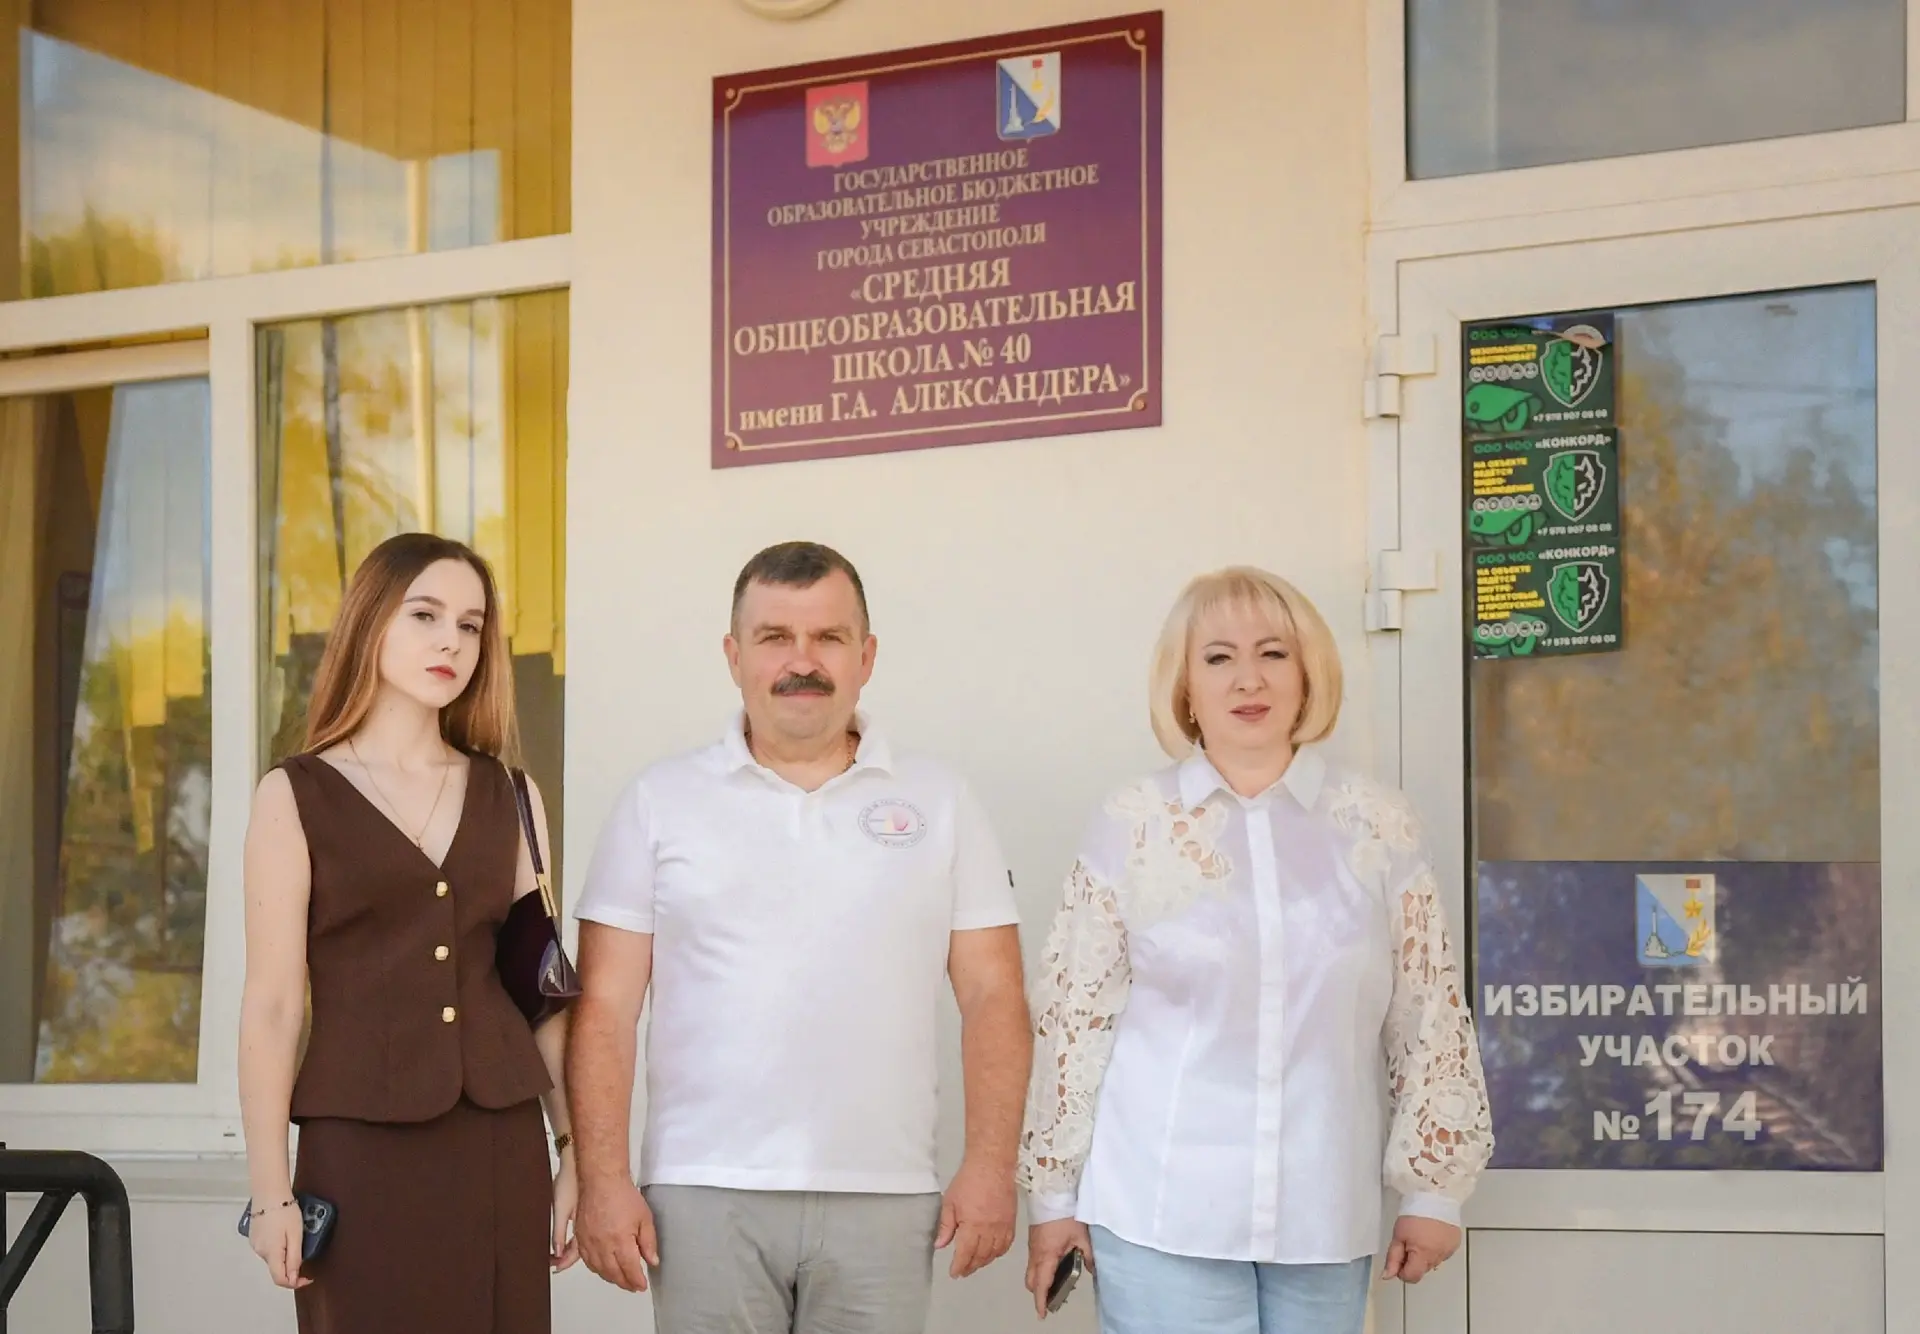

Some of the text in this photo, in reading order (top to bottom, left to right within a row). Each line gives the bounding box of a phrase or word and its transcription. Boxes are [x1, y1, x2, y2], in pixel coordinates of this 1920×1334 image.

[834, 148, 1028, 193] ГОСУДАРСТВЕННОЕ
[767, 164, 1099, 226] ОБРАЗОВАТЕЛЬНОЕ БЮДЖЕТНОЕ
[860, 204, 1000, 240] УЧРЕЖДЕНИЕ
[817, 223, 1046, 271] ГОРОДА СЕВАСТОПОЛЯ
[850, 258, 1011, 303] «СРЕДНЯЯ
[734, 281, 1136, 356] ОБЩЕОБРАЗОВАТЕЛЬНАЯ
[832, 344, 953, 383] ШКОЛА
[1000, 333, 1031, 364] 40
[739, 363, 1131, 431] имени Г.А. АЛЕКСАНДЕРА»
[1535, 434, 1612, 449] «КОНКОРД»
[1538, 545, 1616, 560] «КОНКОРД»
[1484, 975, 1868, 1016] ИЗБИРАТЕЛЬНЫЙ
[1578, 1034, 1775, 1067] УЧАСТОК
